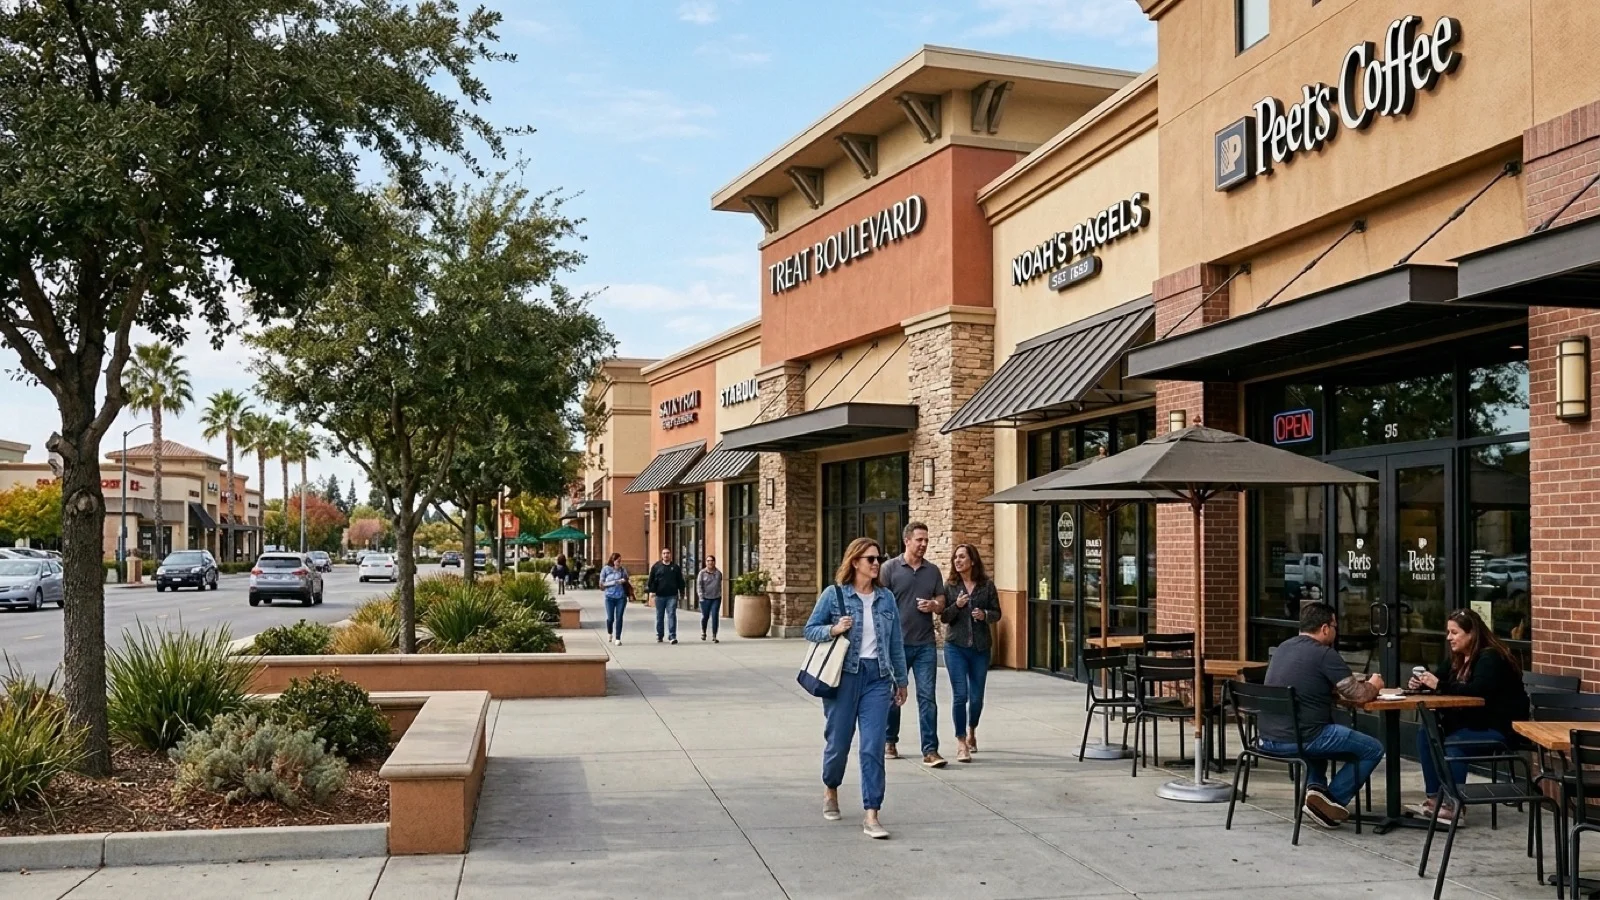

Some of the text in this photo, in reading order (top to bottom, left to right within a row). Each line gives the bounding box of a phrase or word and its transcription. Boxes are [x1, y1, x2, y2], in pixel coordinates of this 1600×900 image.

[1253, 82, 1333, 175] Peet's
[1338, 15, 1458, 129] Coffee
[768, 194, 925, 295] TREAT BOULEVARD
[1012, 192, 1147, 287] NOAH'S BAGELS
[1276, 413, 1311, 441] OPEN
